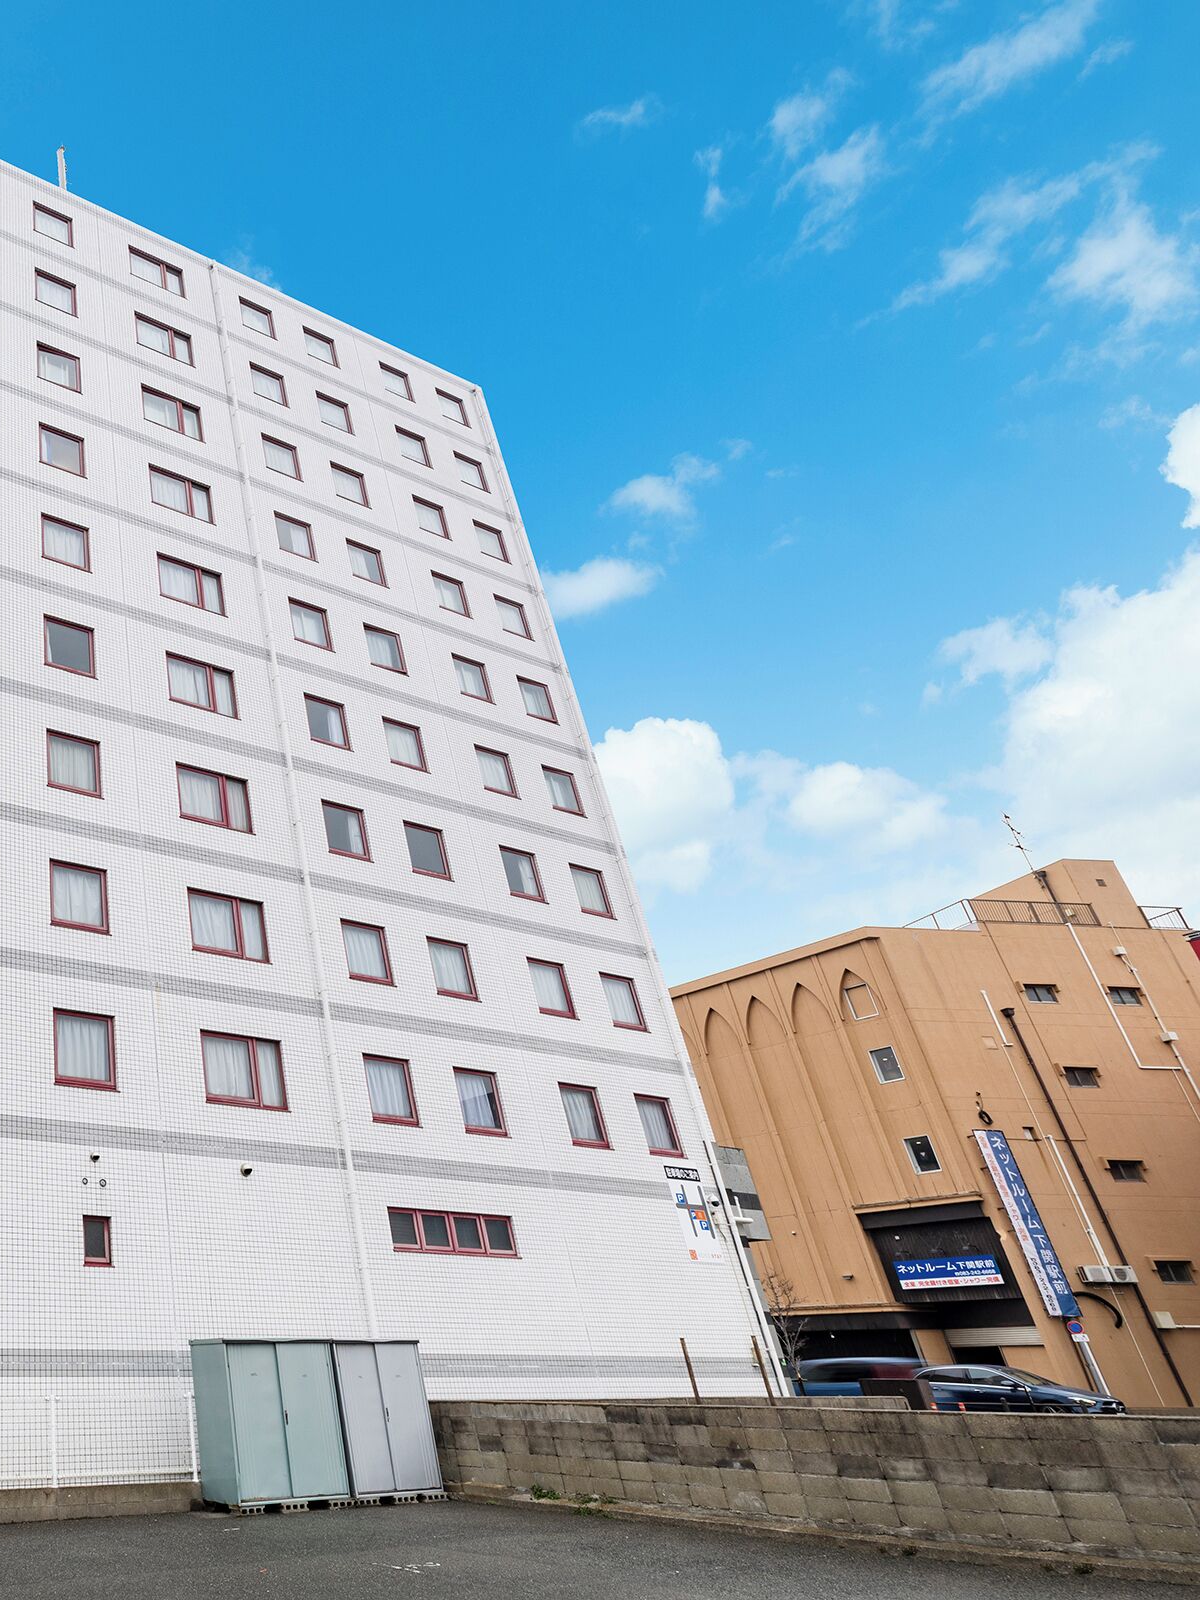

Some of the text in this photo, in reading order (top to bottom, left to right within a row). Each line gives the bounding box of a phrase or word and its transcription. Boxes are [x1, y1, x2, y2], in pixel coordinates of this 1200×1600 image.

[990, 1135, 1068, 1295] ネットルーム下関駅前
[897, 1259, 995, 1274] ネットルーム下関駅前
